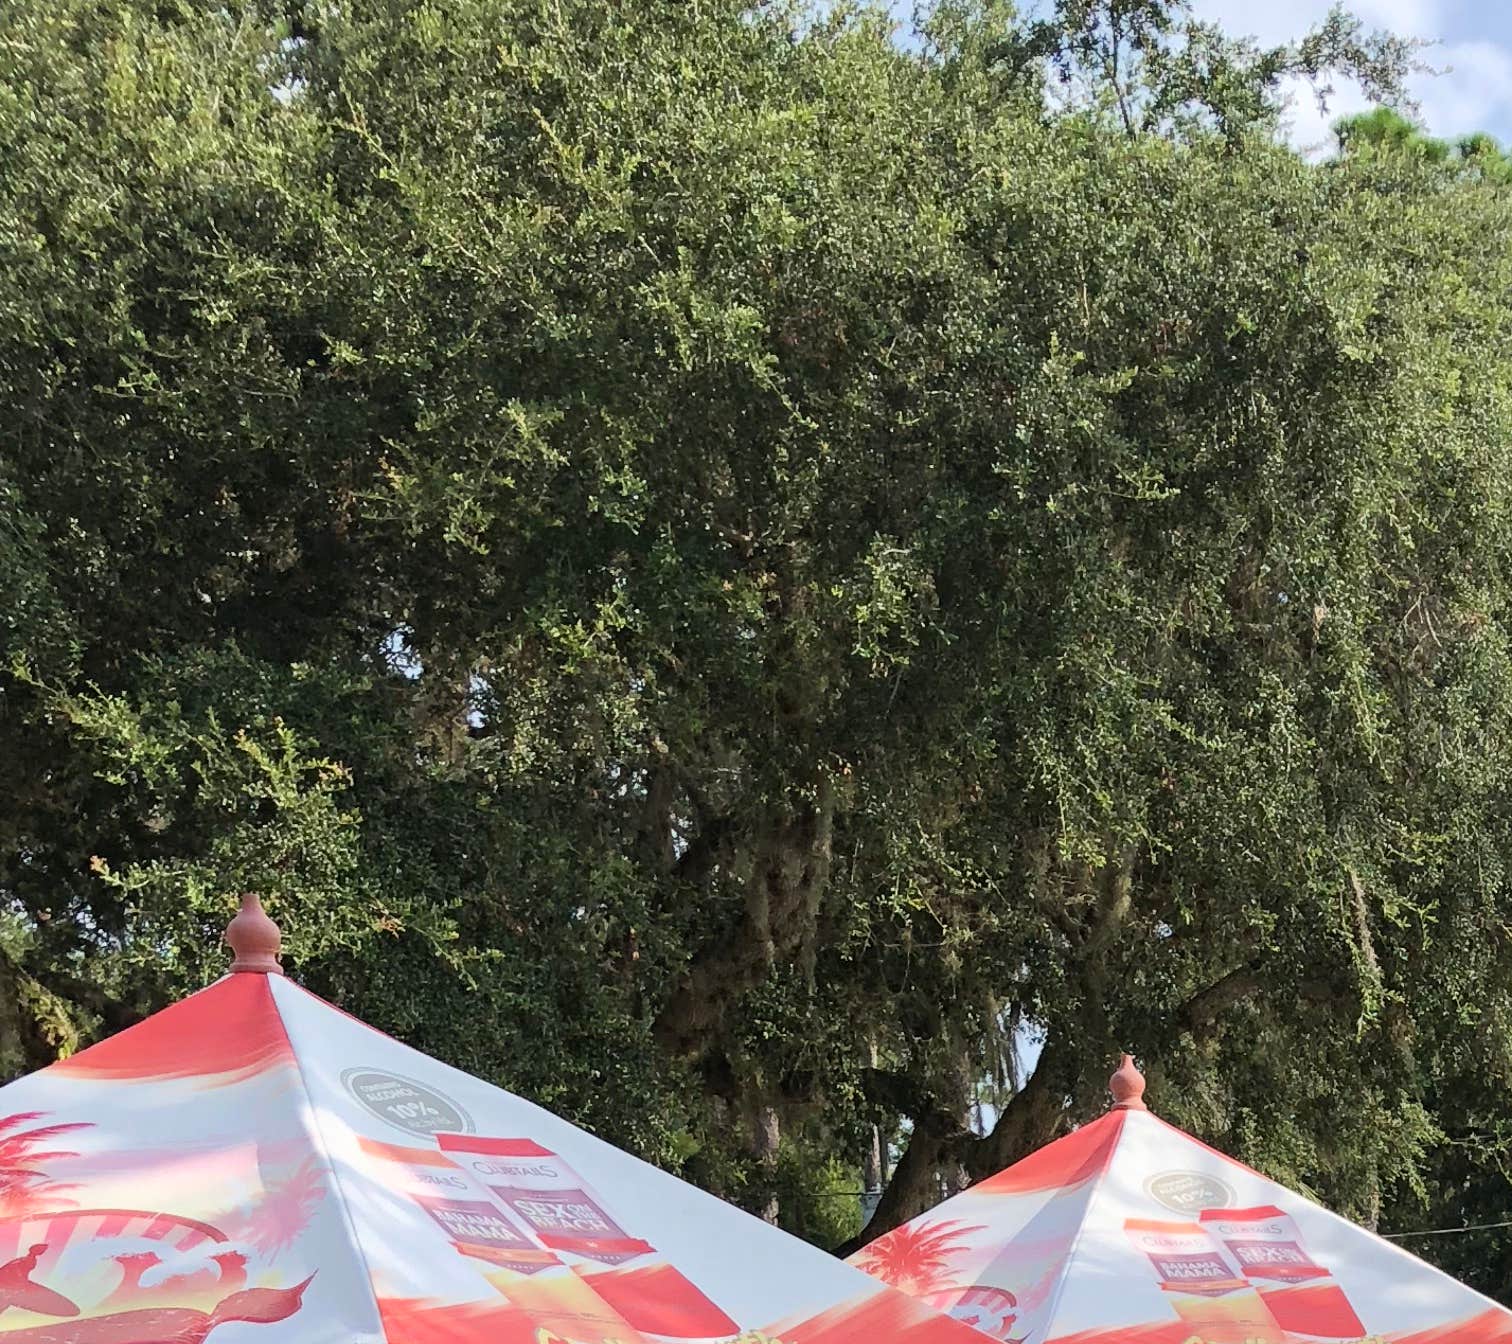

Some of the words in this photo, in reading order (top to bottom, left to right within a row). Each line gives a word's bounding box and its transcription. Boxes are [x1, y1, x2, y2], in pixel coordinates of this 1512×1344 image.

[386, 1101, 440, 1120] 10%
[472, 1160, 559, 1179] CLUBTAILS
[431, 1208, 506, 1228] BAHAMA
[513, 1200, 570, 1217] SEX
[528, 1213, 610, 1232] BEACH
[448, 1223, 522, 1242] MAMA
[1159, 1260, 1221, 1271] BAHAMA
[1165, 1268, 1227, 1279] MAMA
